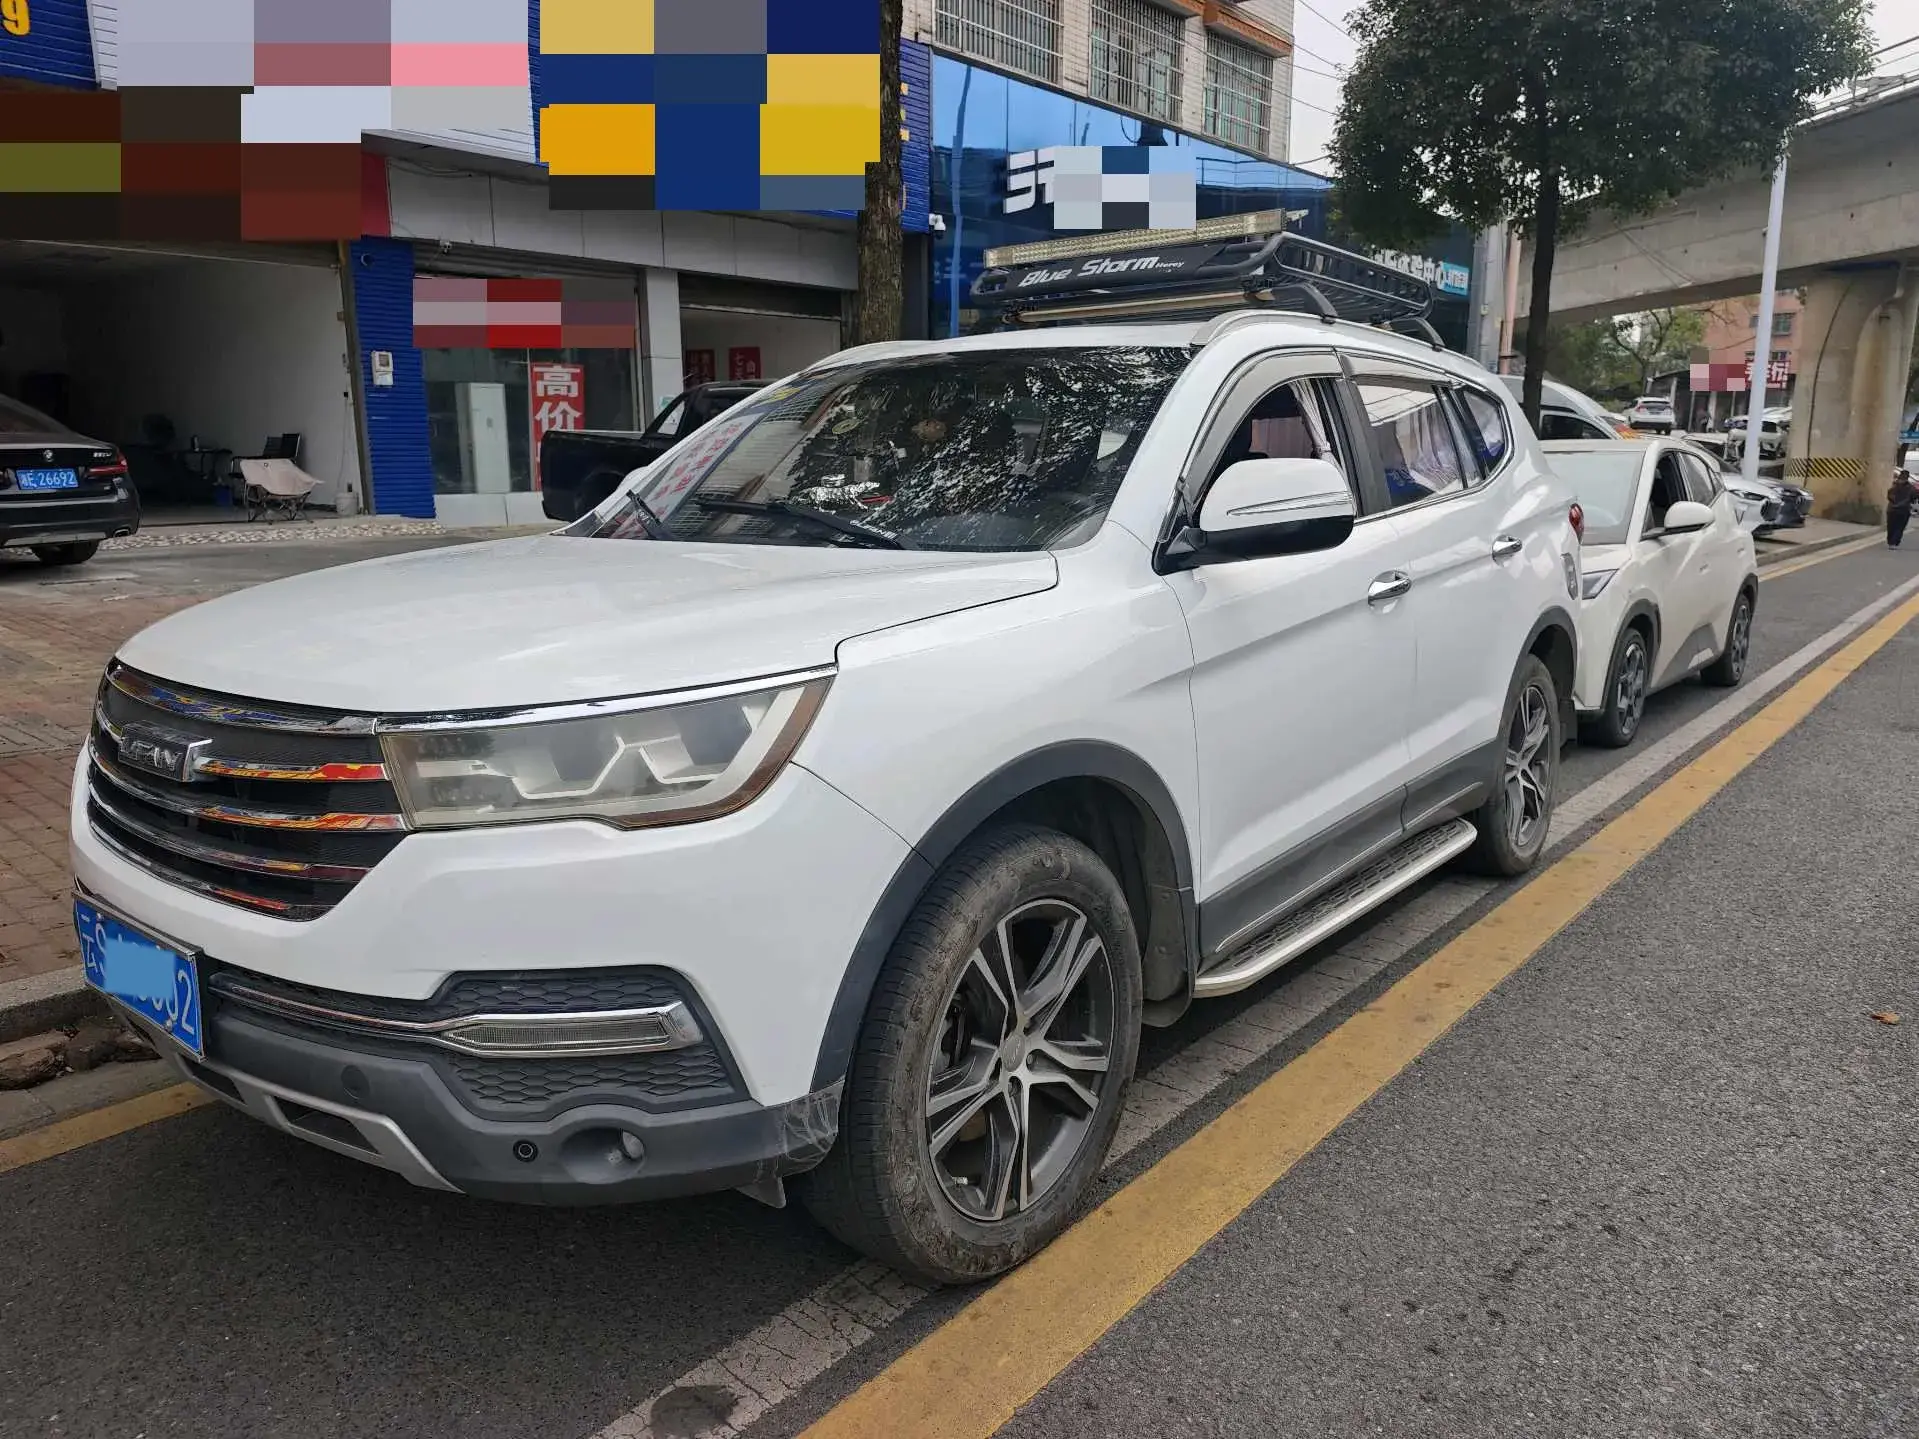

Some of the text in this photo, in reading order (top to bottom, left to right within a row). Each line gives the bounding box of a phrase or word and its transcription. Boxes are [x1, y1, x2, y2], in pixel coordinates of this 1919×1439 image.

[1018, 268, 1073, 288] Blue
[1077, 256, 1159, 277] Storm
[533, 365, 582, 463] 高价
